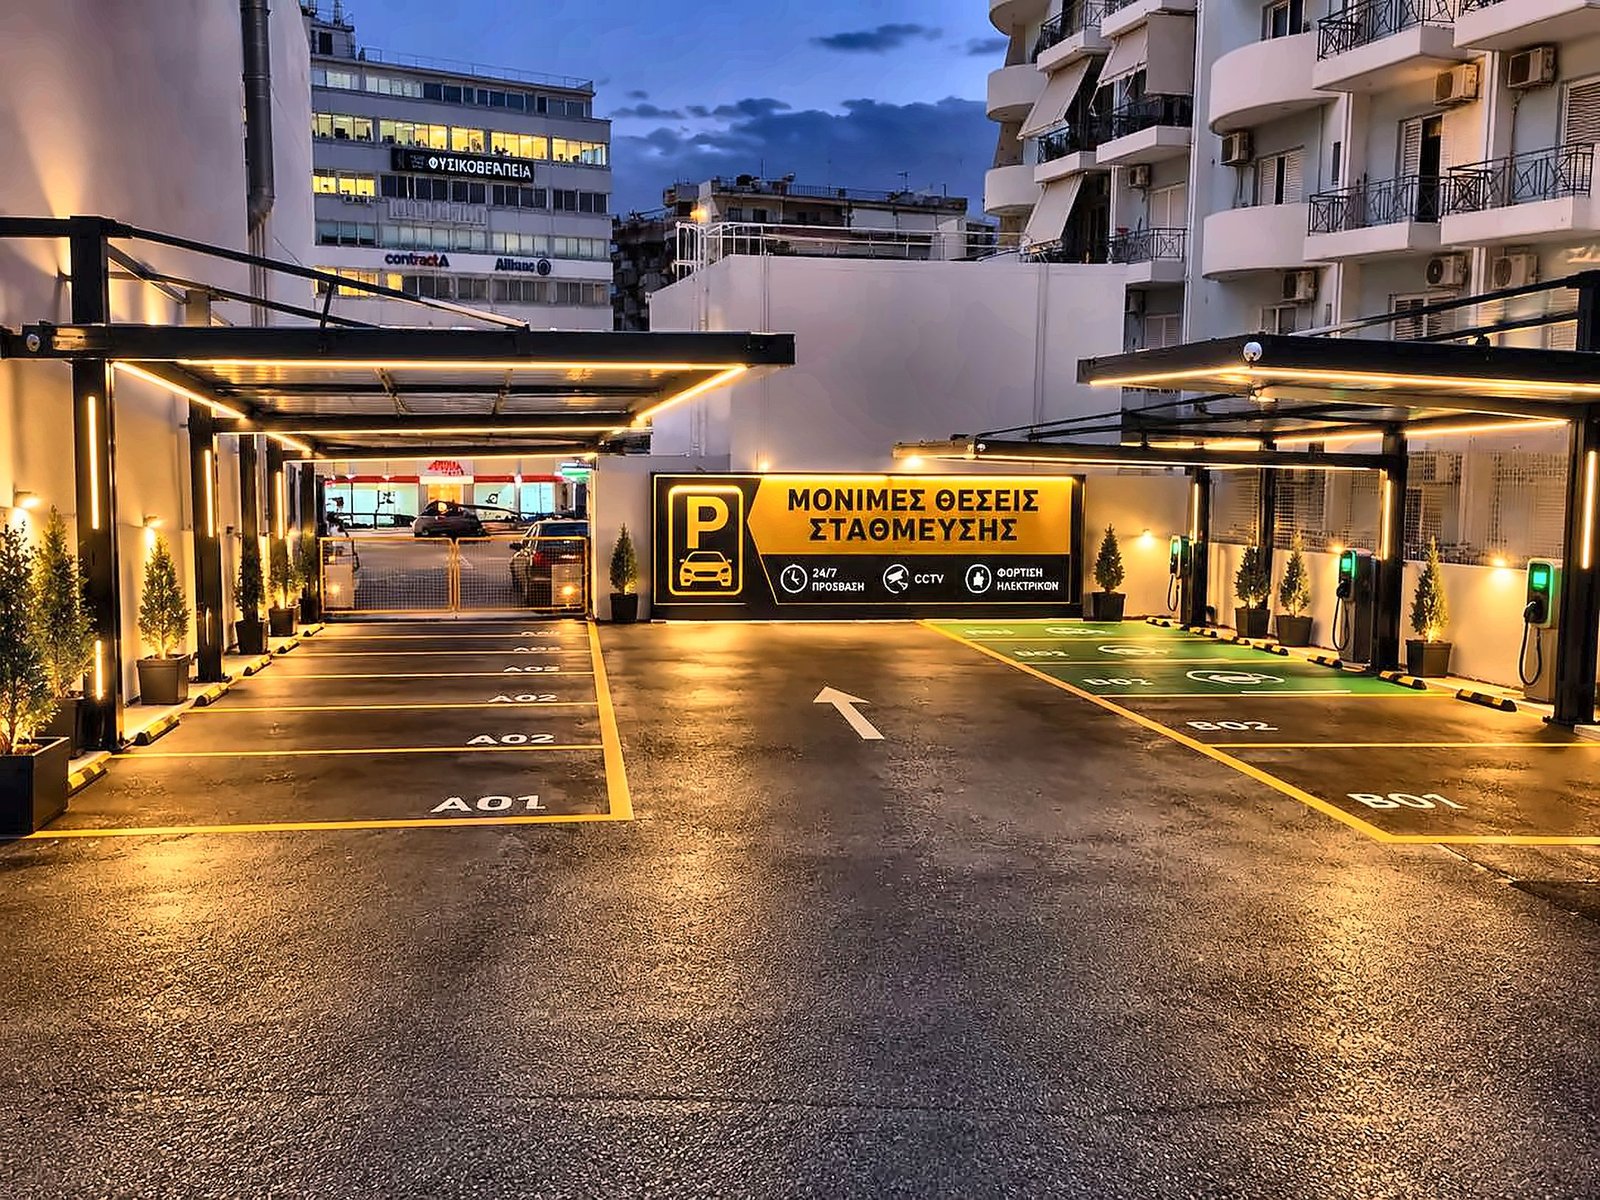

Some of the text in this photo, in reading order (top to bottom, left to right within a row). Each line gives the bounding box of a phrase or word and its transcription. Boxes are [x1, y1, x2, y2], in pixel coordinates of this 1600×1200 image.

[788, 488, 1039, 512] ΜΟΝΙΜΕΣ ΘΕΣΕΙΣ
[687, 495, 729, 549] P
[809, 517, 1018, 541] ΣΤΑΘΜΕΥΣΗΣ
[812, 567, 838, 578] 24/7
[914, 573, 945, 584] CCTV
[996, 567, 1043, 578] ΦΟΡΤΙΣΗ
[487, 693, 558, 703] A02
[1186, 720, 1279, 732] B02
[466, 733, 555, 745] A02
[430, 794, 547, 813] A01
[1346, 793, 1469, 810] B01
